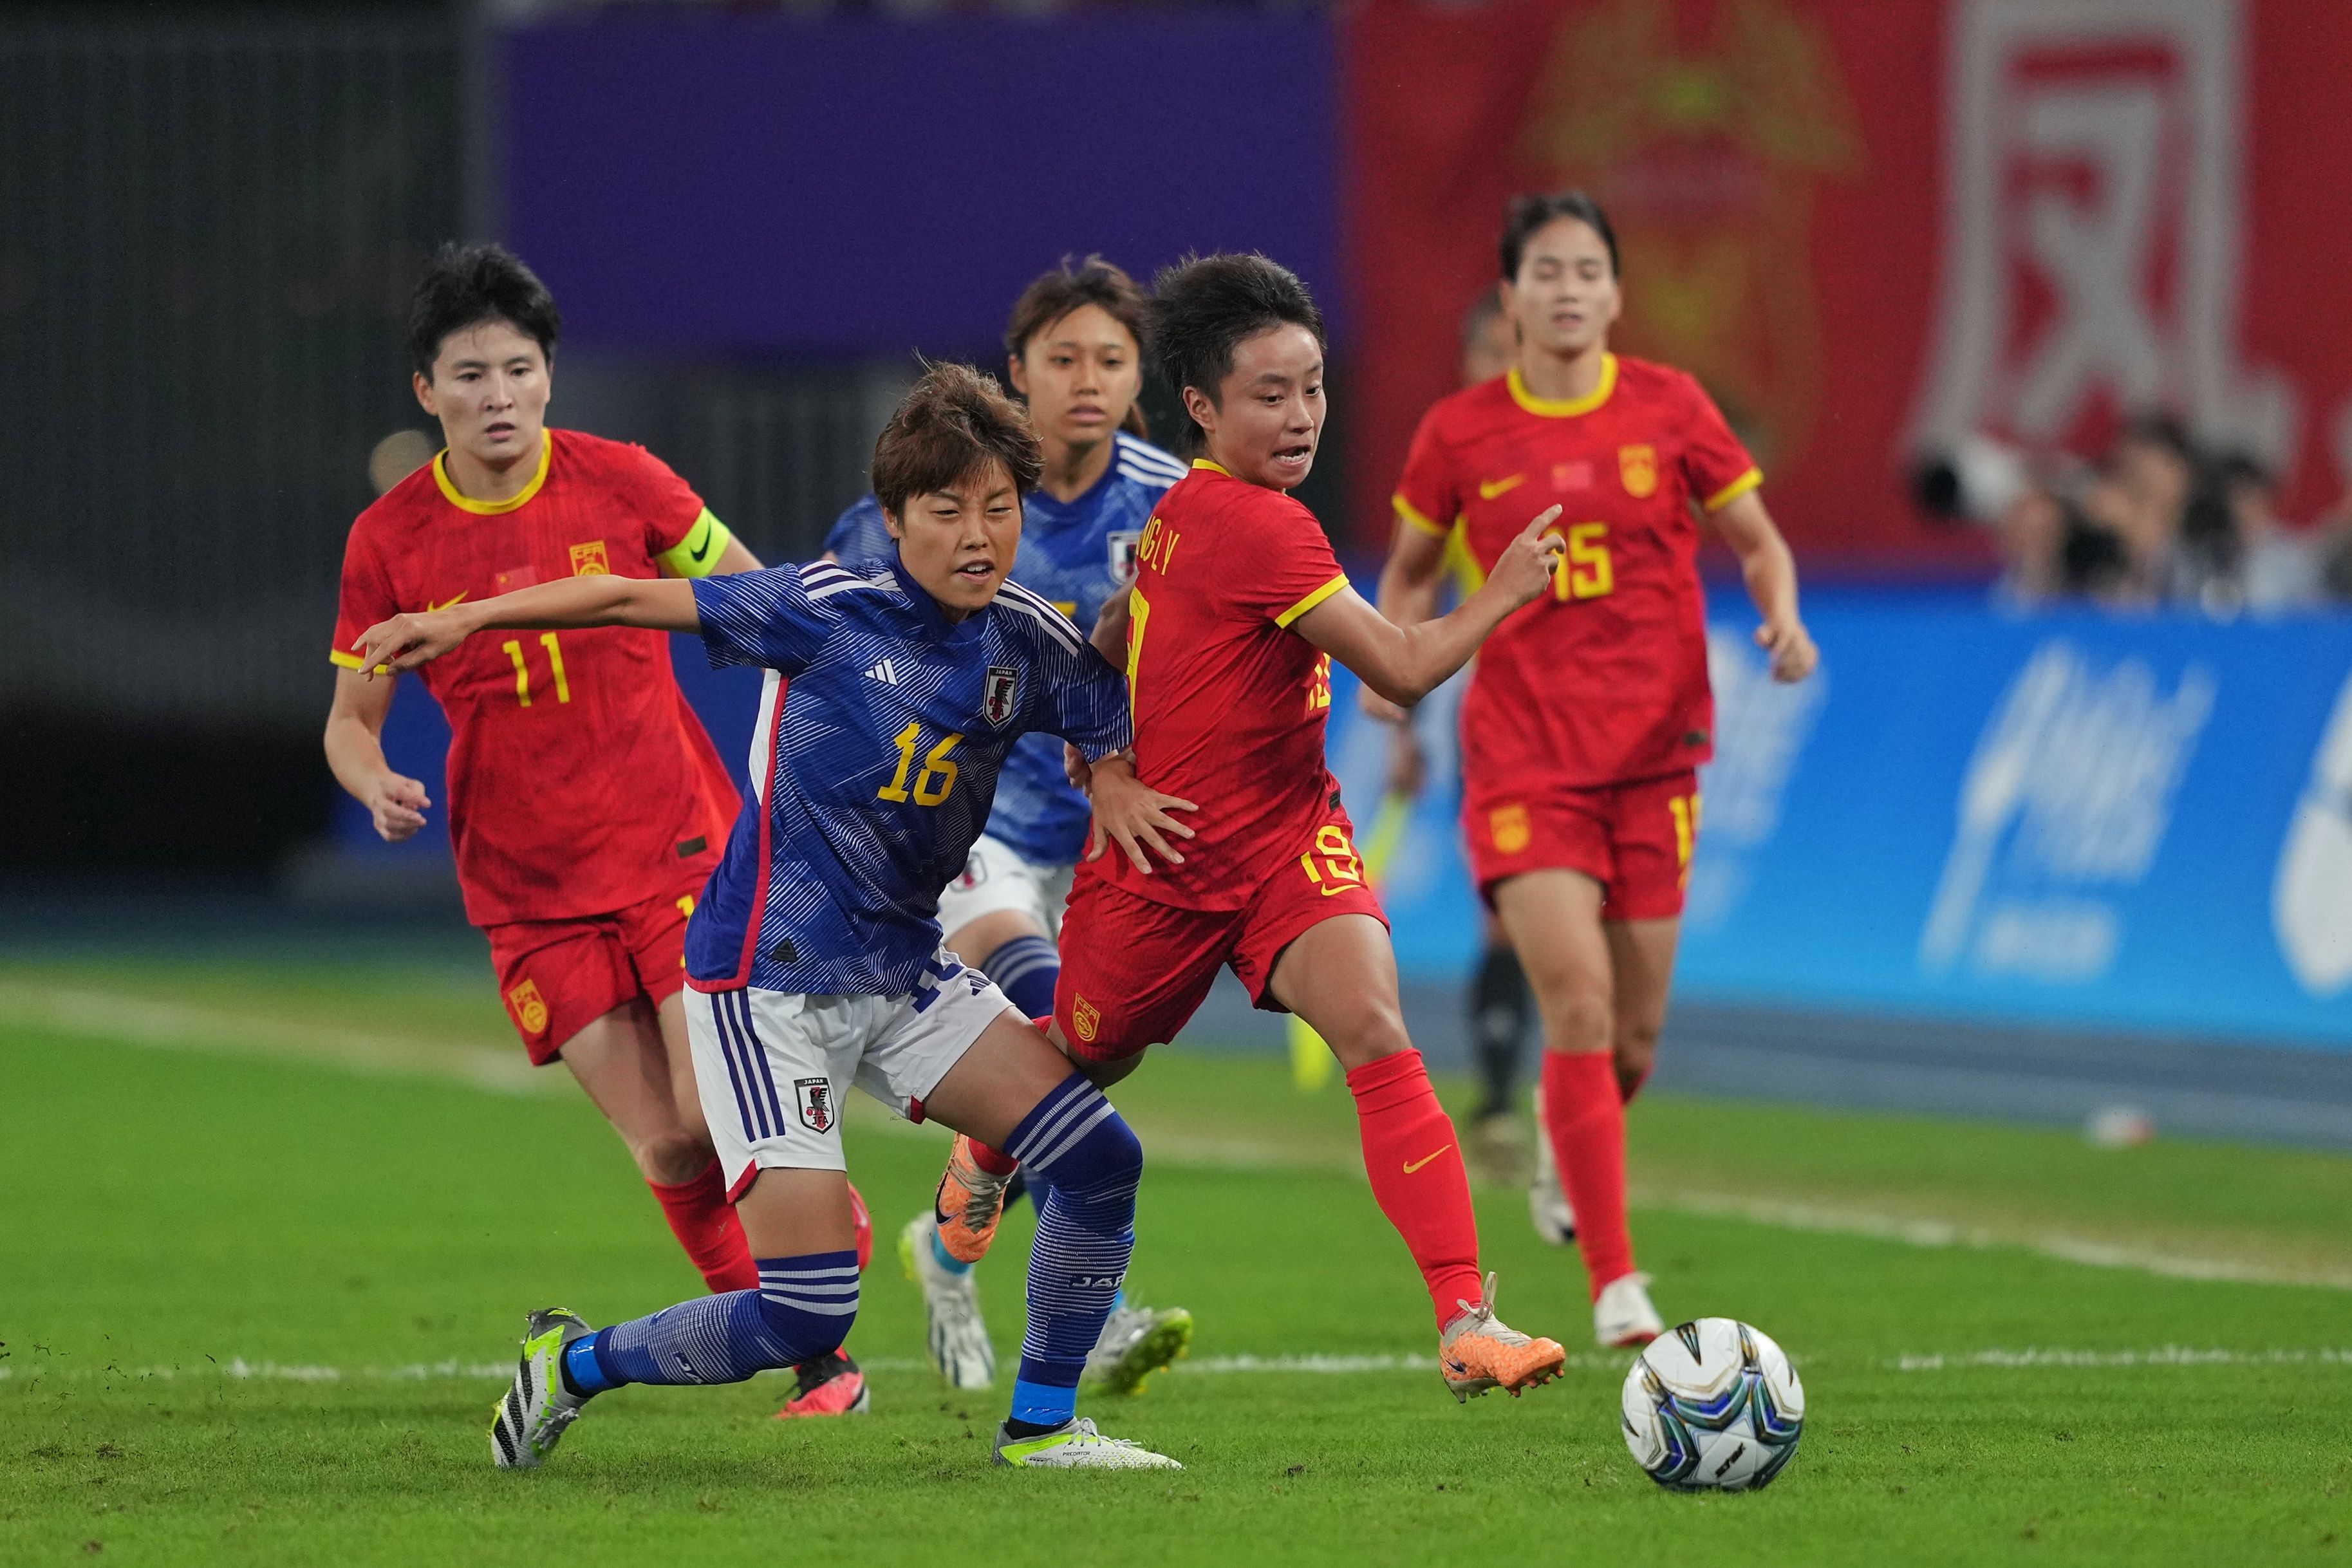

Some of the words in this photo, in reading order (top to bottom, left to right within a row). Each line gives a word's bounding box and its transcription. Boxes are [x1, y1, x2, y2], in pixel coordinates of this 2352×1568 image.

[502, 631, 570, 707] 11
[877, 722, 965, 807] 16
[1300, 825, 1360, 884] 19
[1078, 996, 1097, 1020] CFA
